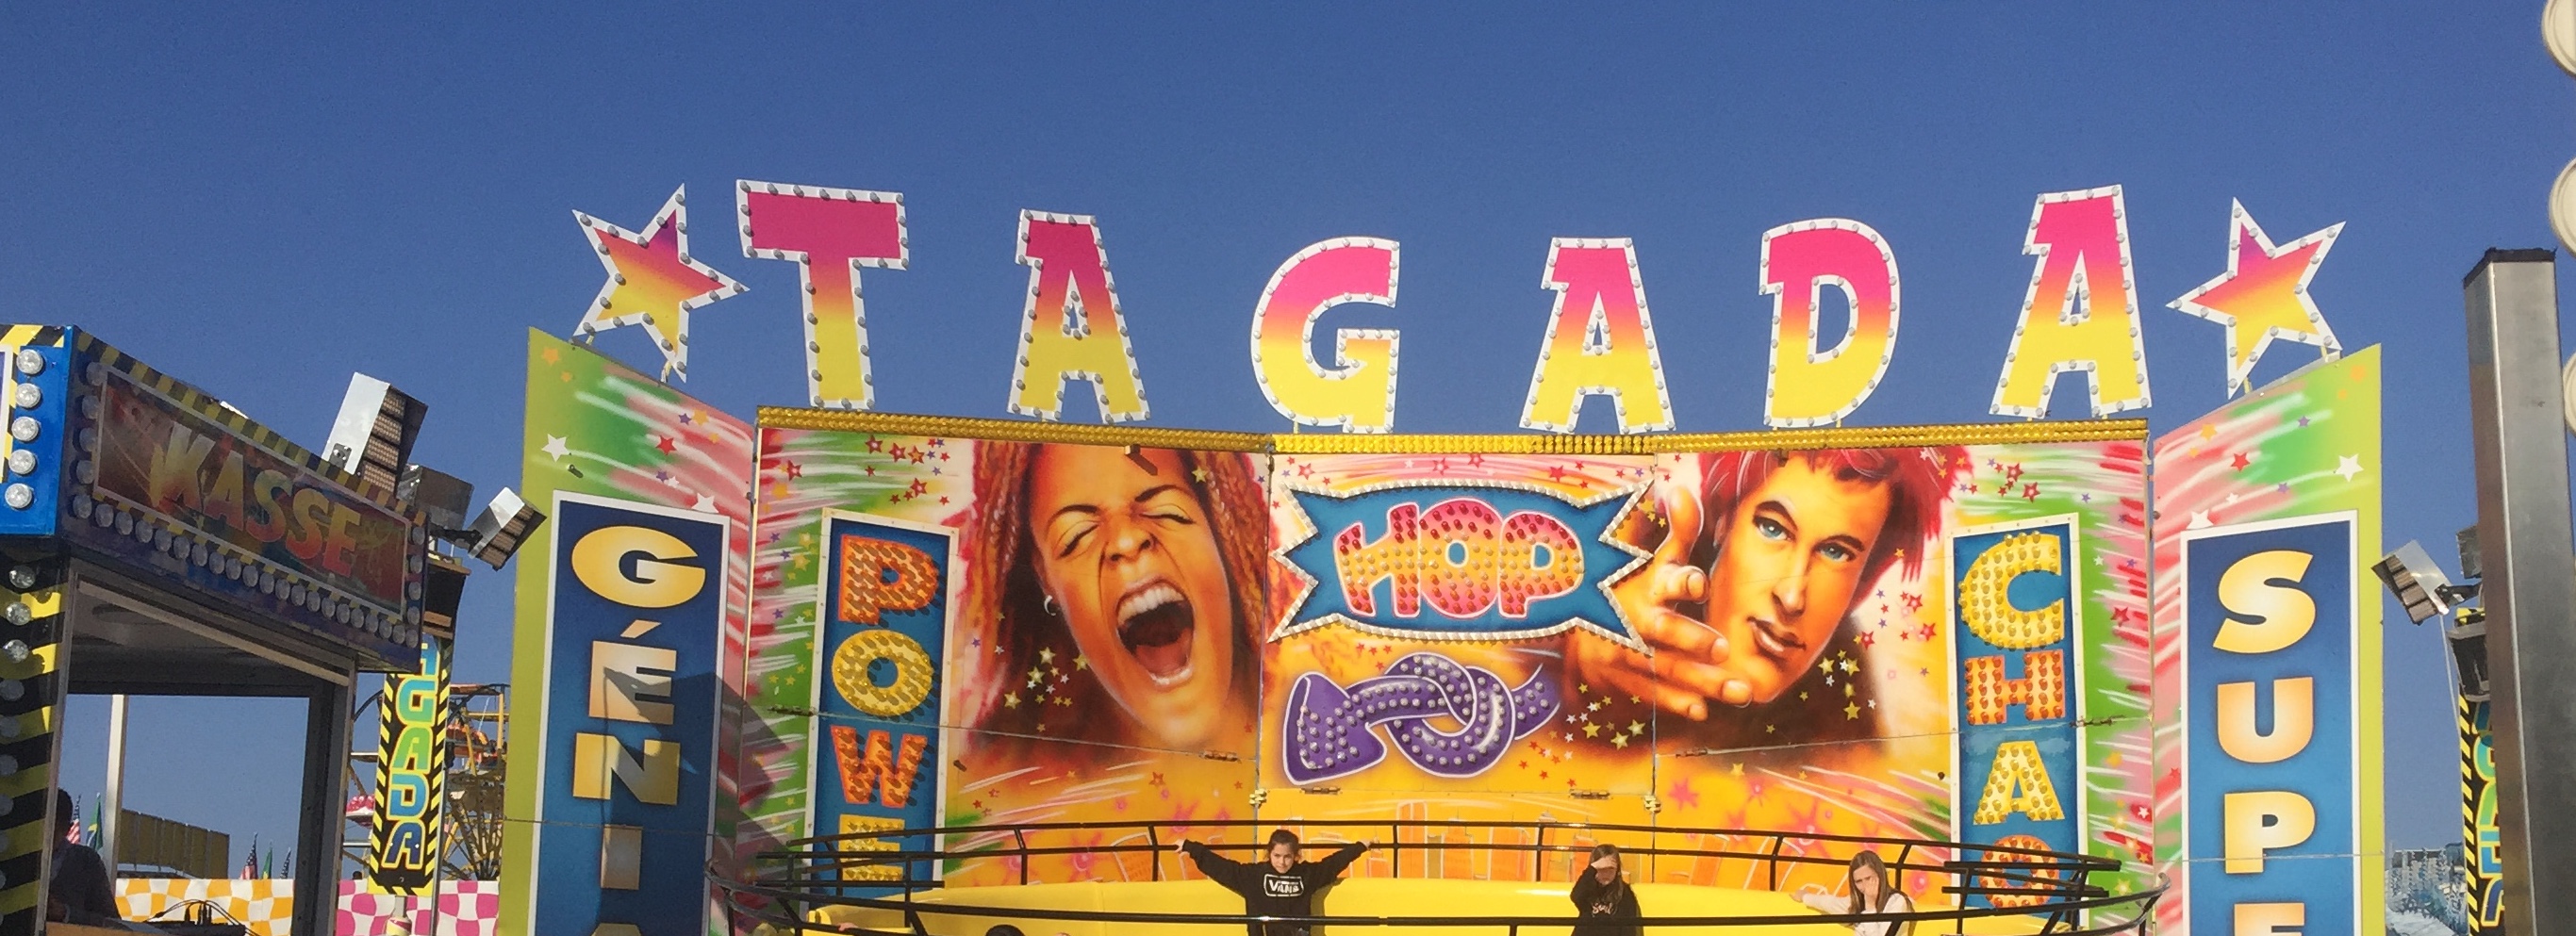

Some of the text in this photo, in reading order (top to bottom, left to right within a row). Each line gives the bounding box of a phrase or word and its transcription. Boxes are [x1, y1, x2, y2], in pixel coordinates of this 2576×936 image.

[736, 179, 2153, 435] TAGADA
[148, 421, 362, 579] KASSE
[1332, 496, 1585, 619] HOP
[570, 525, 706, 936] GÉNI
[1268, 879, 1300, 894] VANS
